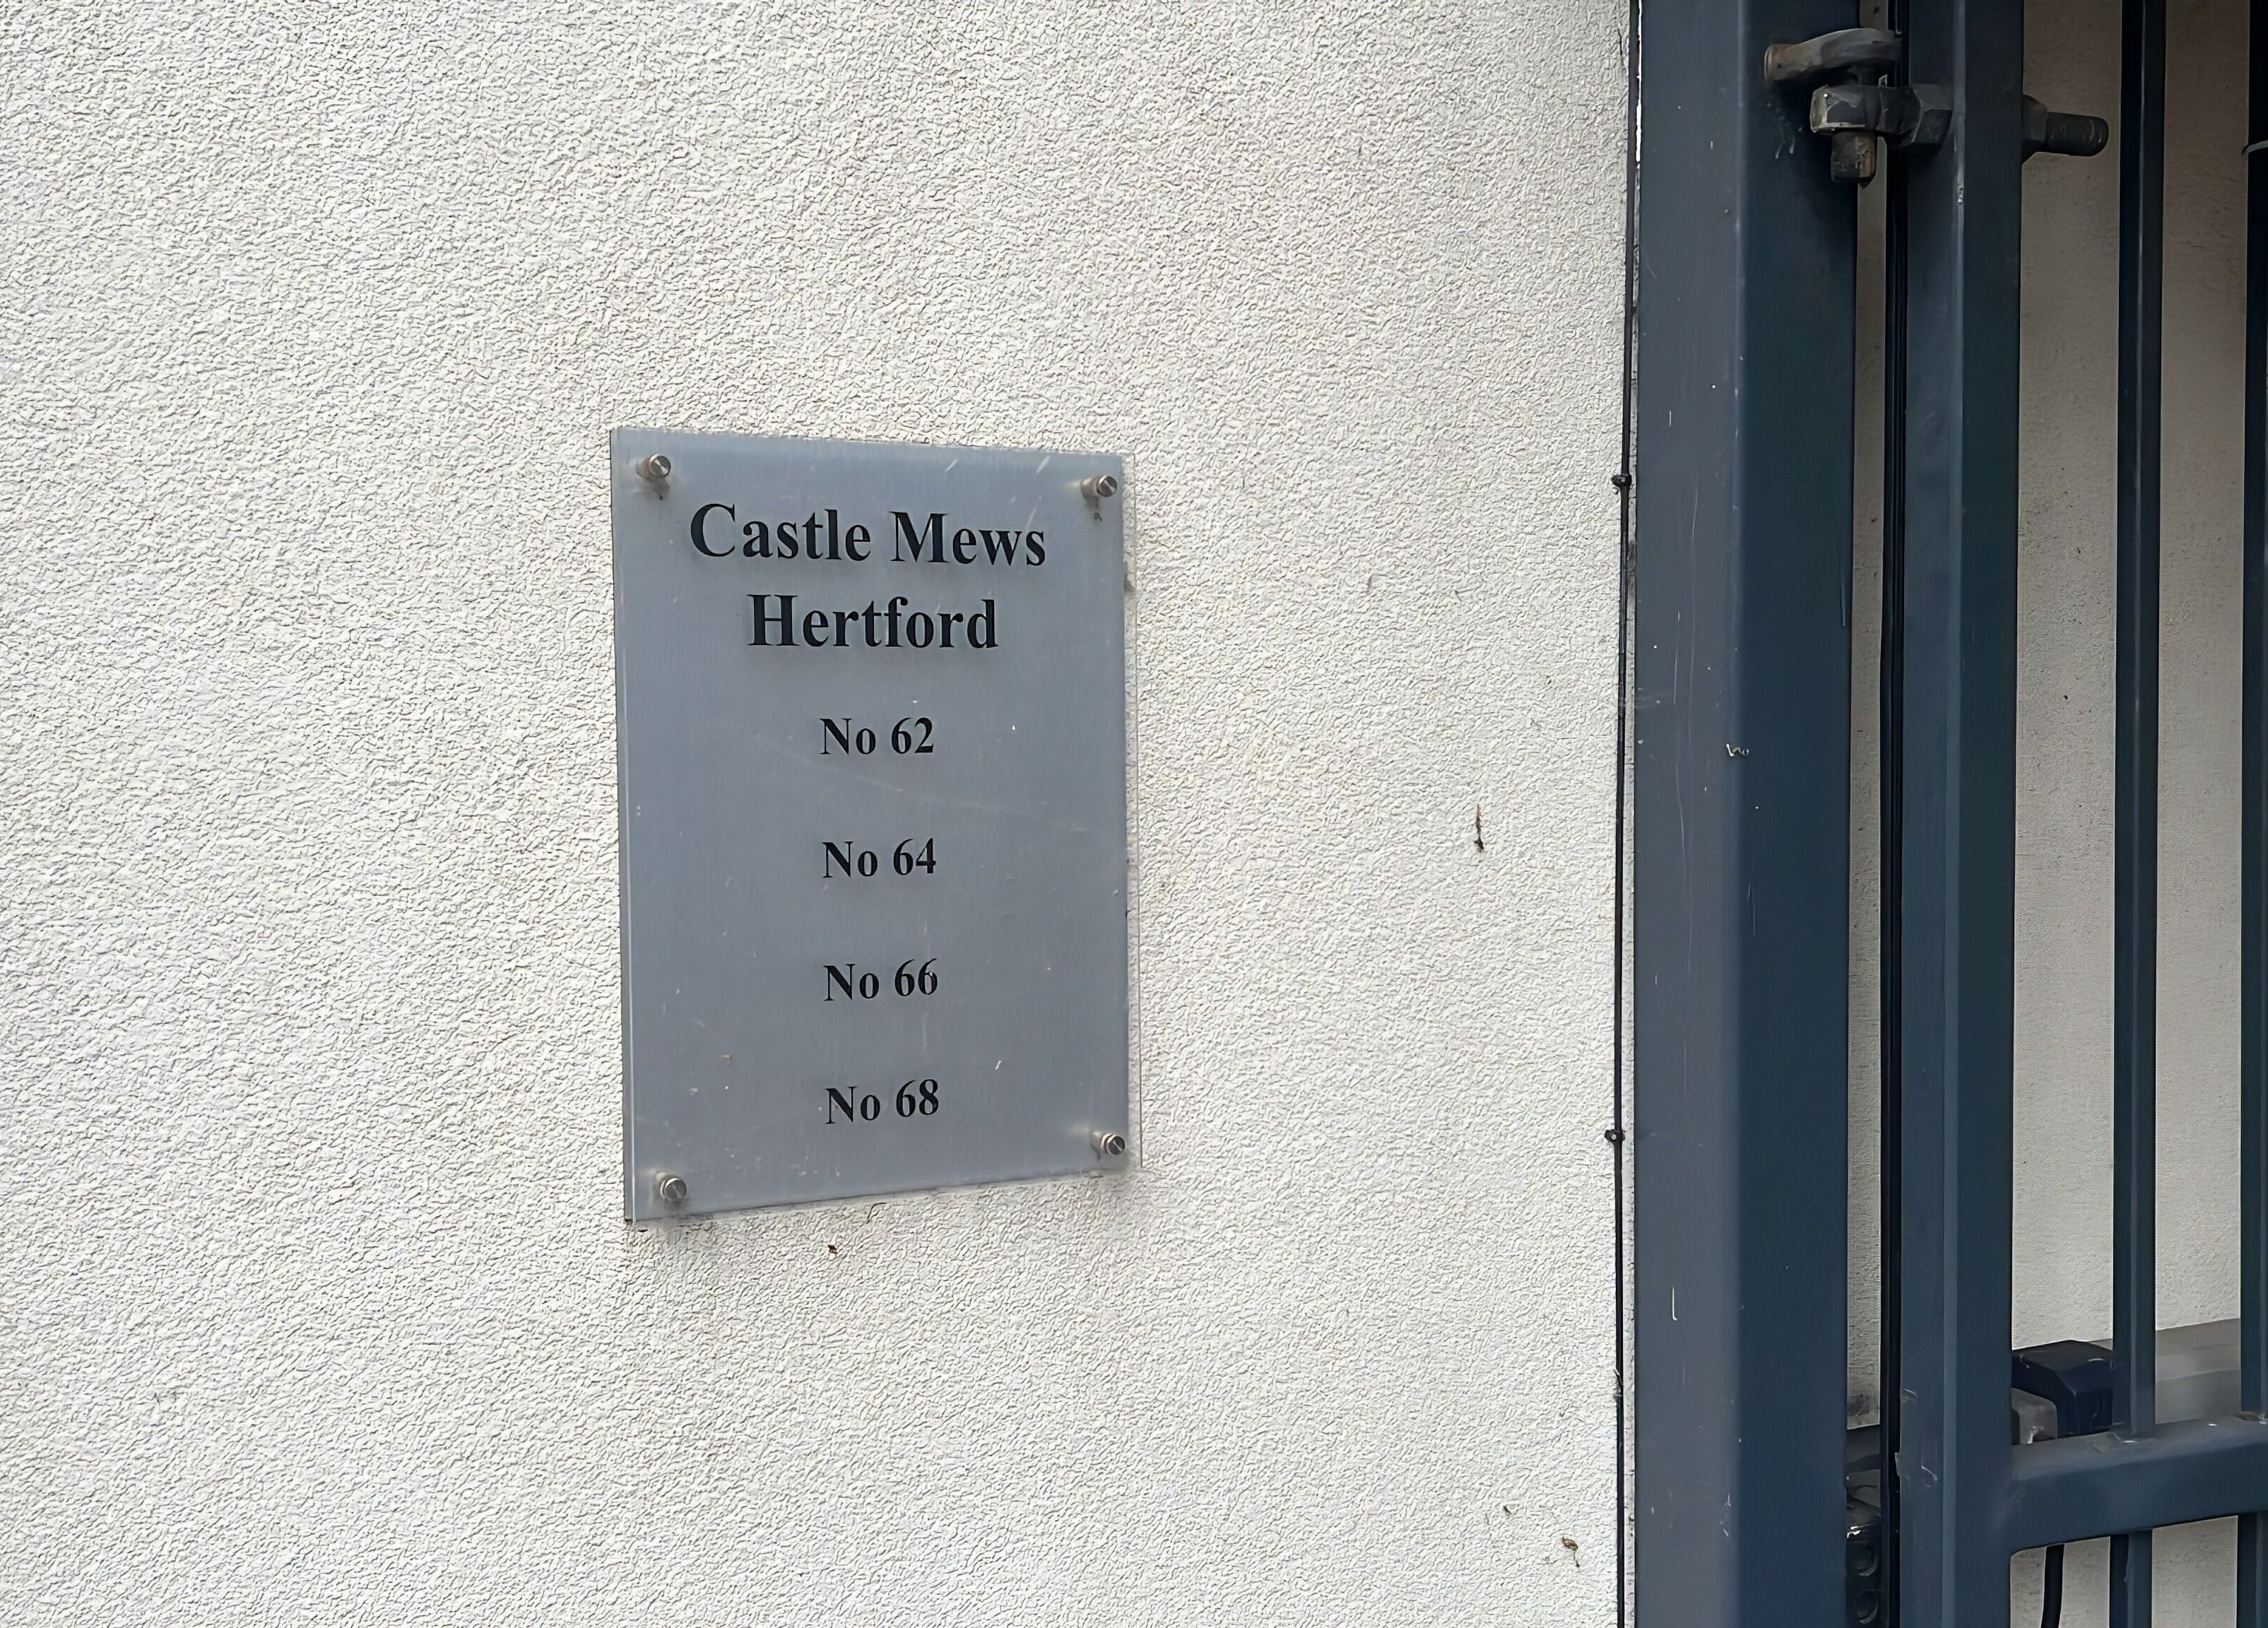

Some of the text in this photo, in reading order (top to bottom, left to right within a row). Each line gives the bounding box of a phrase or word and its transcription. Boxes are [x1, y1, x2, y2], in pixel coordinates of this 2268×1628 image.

[690, 503, 1046, 567] Castle Mews
[746, 594, 999, 649] Hertford
[820, 716, 934, 755] No 62
[821, 837, 936, 878] No 64
[822, 957, 938, 1002] No 66
[825, 1078, 939, 1125] No 68
